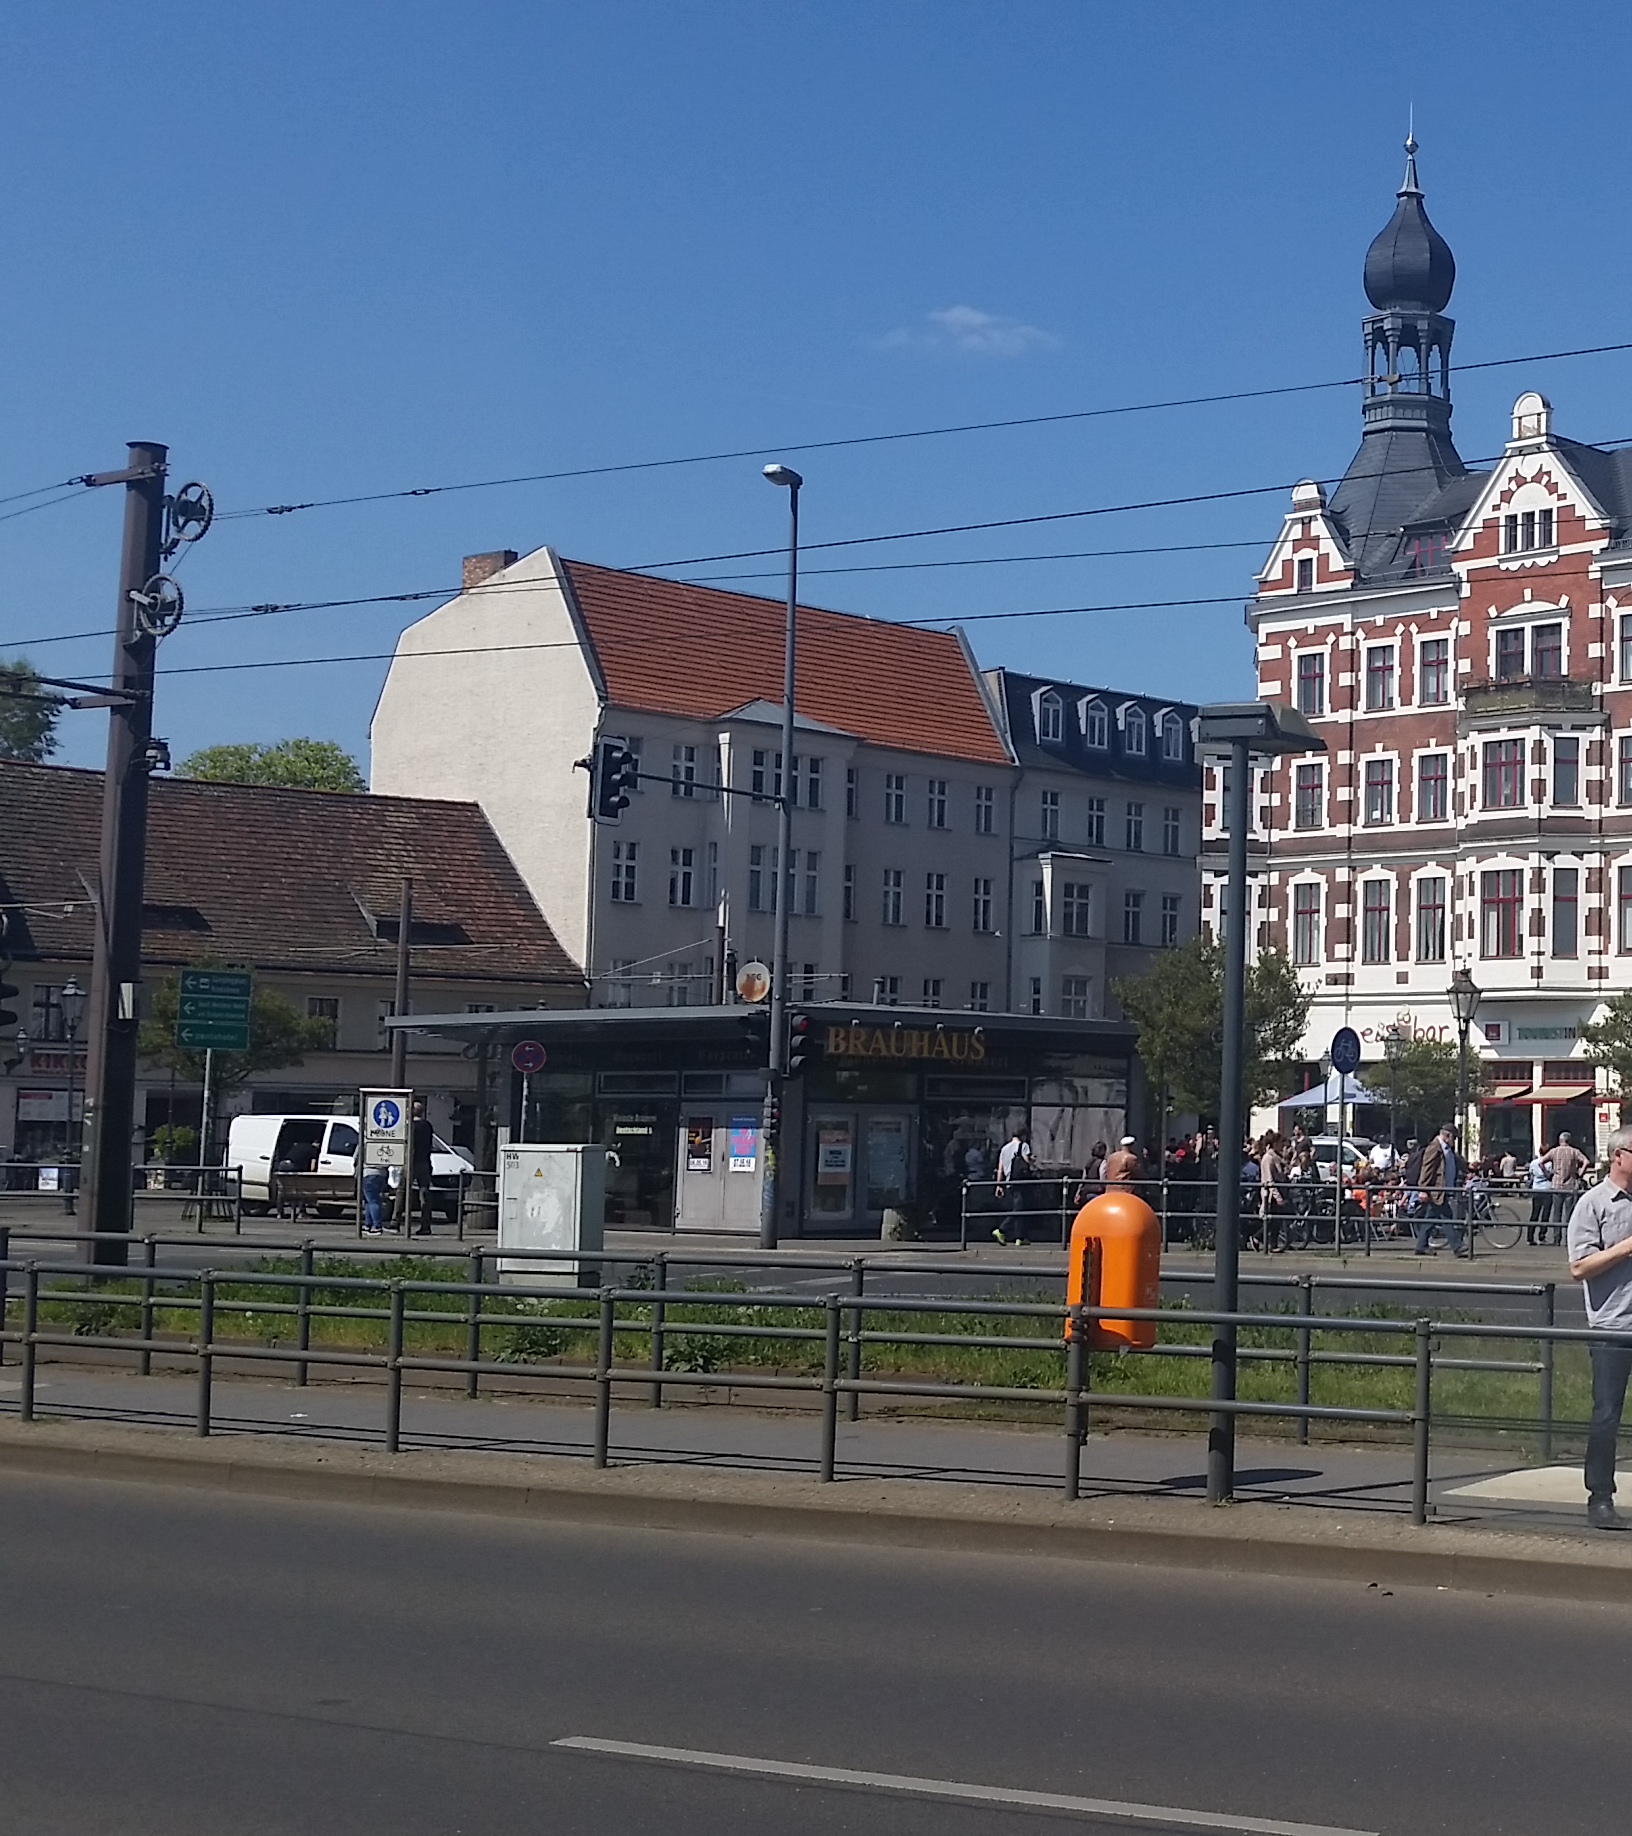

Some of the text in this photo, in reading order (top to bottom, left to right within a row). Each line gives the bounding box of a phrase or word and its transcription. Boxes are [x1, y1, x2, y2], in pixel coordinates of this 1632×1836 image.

[827, 1026, 986, 1060] BRAUHAUS
[1413, 1015, 1450, 1045] bar
[506, 1152, 519, 1160] HW
